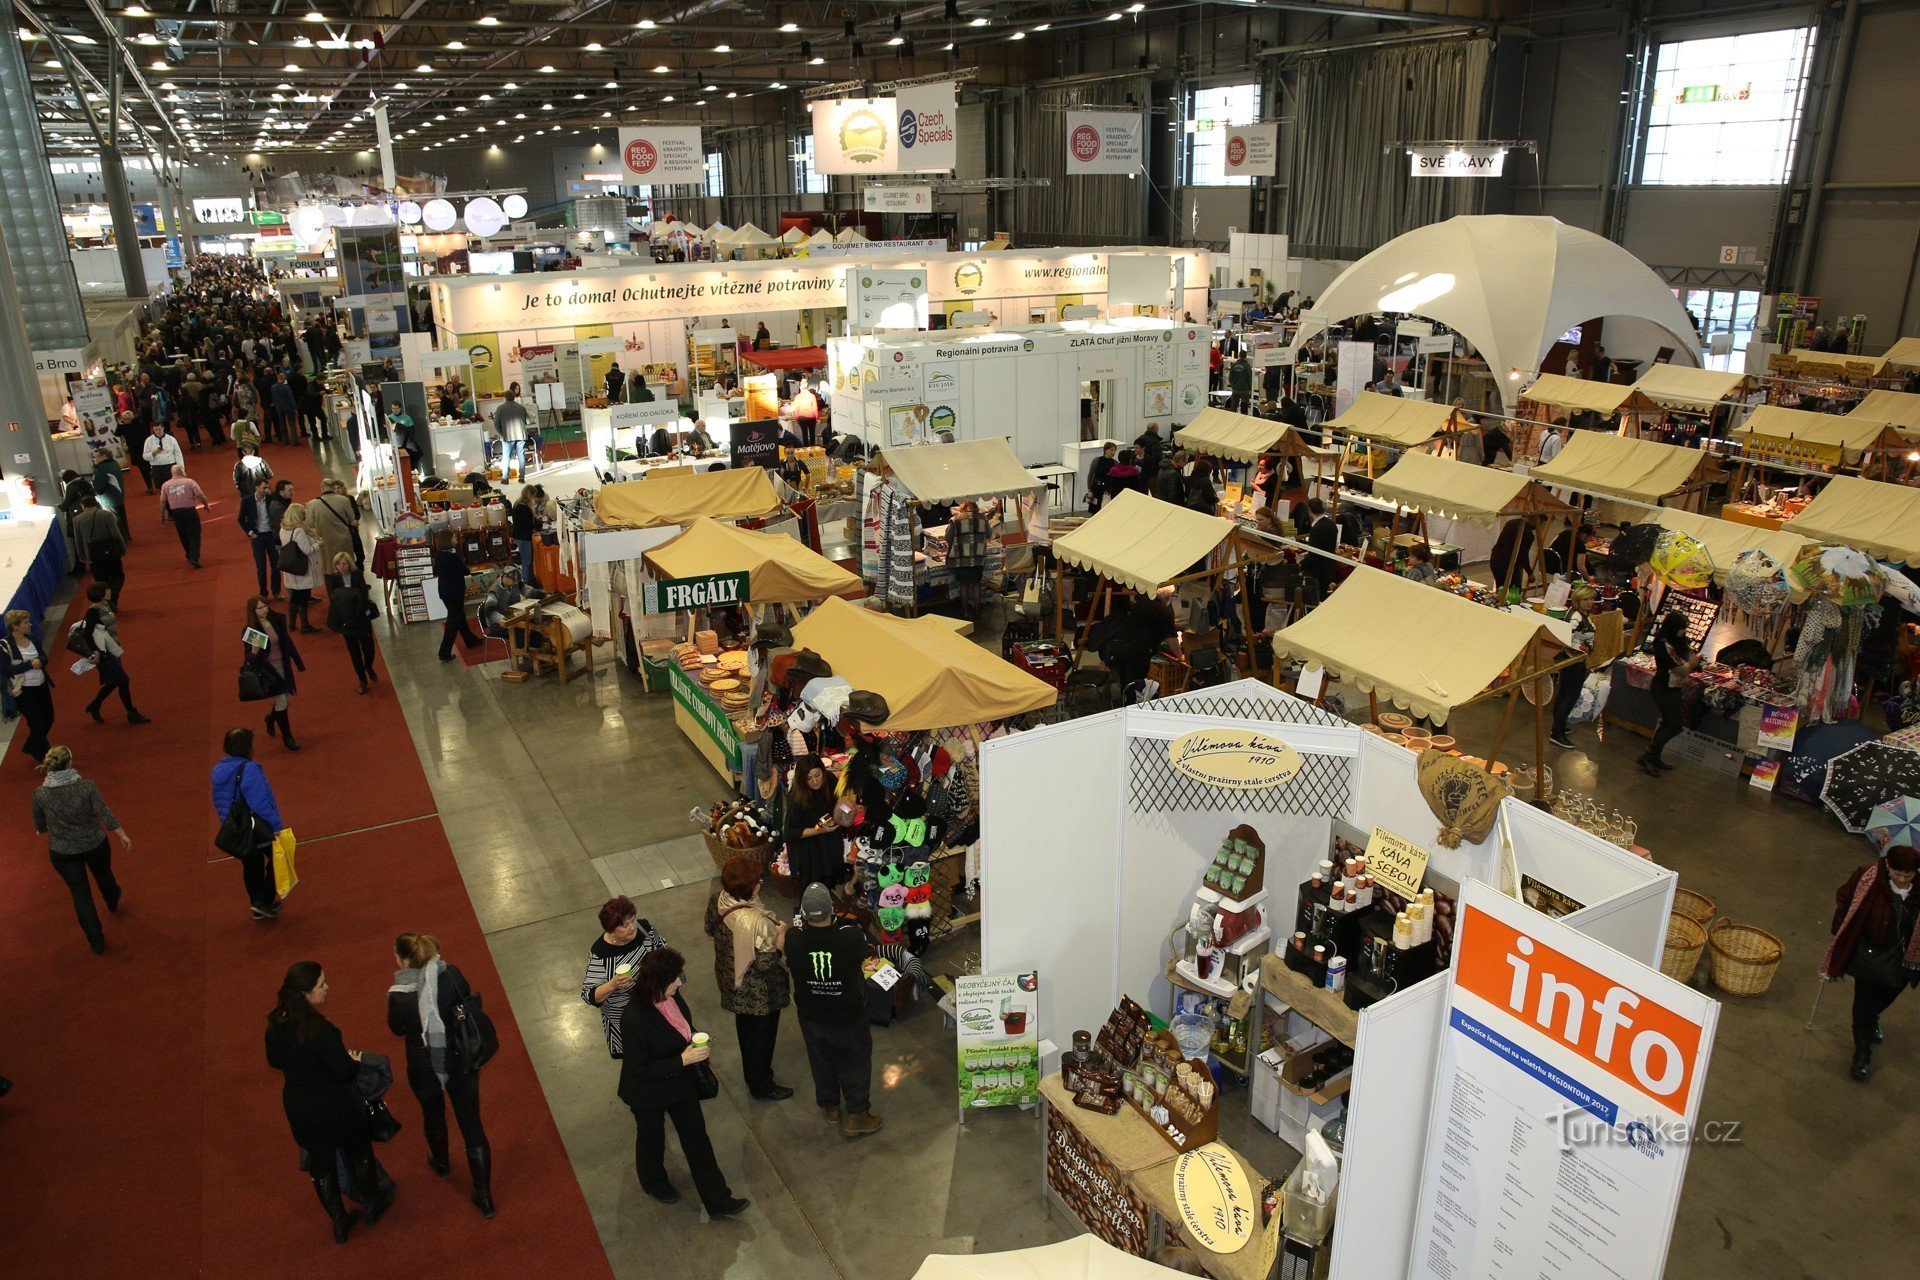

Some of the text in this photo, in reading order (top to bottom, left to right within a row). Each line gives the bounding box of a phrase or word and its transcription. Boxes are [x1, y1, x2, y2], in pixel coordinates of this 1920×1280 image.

[918, 110, 944, 126] Czech
[918, 126, 953, 146] Specials
[1077, 147, 1094, 155] FEST
[1420, 155, 1495, 168] SVĚT KÁVY
[1724, 248, 1733, 262] 8
[1023, 265, 1109, 280] www.regionaln
[522, 293, 540, 311] Je
[546, 293, 563, 307] to
[568, 288, 618, 306] doma!
[622, 283, 706, 303] Ochutnejte
[710, 278, 763, 296] vítězné
[767, 275, 836, 295] potraviny
[1070, 333, 1159, 347] ZLATÁ Chuť jižní Moravy
[936, 344, 1019, 359] Regionální potravina
[47, 359, 77, 370] Brno
[650, 408, 675, 416] DAVÍDKA
[737, 442, 776, 456] Matějovo
[1750, 437, 1818, 458] MINERÁLY
[666, 577, 739, 608] FRGÁLY
[1182, 736, 1244, 758] Vilémova
[1248, 755, 1276, 765] 1910
[1176, 757, 1292, 787] Z vlastní pražírny stále čerstvá
[1375, 827, 1427, 861] Vilémova káva
[1379, 846, 1411, 869] KÁVA
[1365, 855, 1418, 888] S SEBOU
[1526, 876, 1561, 900] Vilémova
[957, 977, 1016, 989] NEOBYČEJNÝ ČAJ
[1505, 936, 1685, 1097] info
[1461, 1018, 1609, 1113] Expozice řemesel na veletrhu REGIONTOUR 2017
[1636, 1144, 1655, 1160] TOUR
[1637, 1135, 1664, 1157] REGION
[1056, 1130, 1141, 1229] Daiquiriki Bar
[1201, 1149, 1237, 1202] Vilémova
[1093, 1193, 1101, 1206] &
[1103, 1204, 1131, 1238] coffee
[1176, 1173, 1187, 1201] pražírny
[1182, 1203, 1195, 1220] stále
[1190, 1219, 1215, 1246] čerstvá
[1212, 1205, 1226, 1230] 1910
